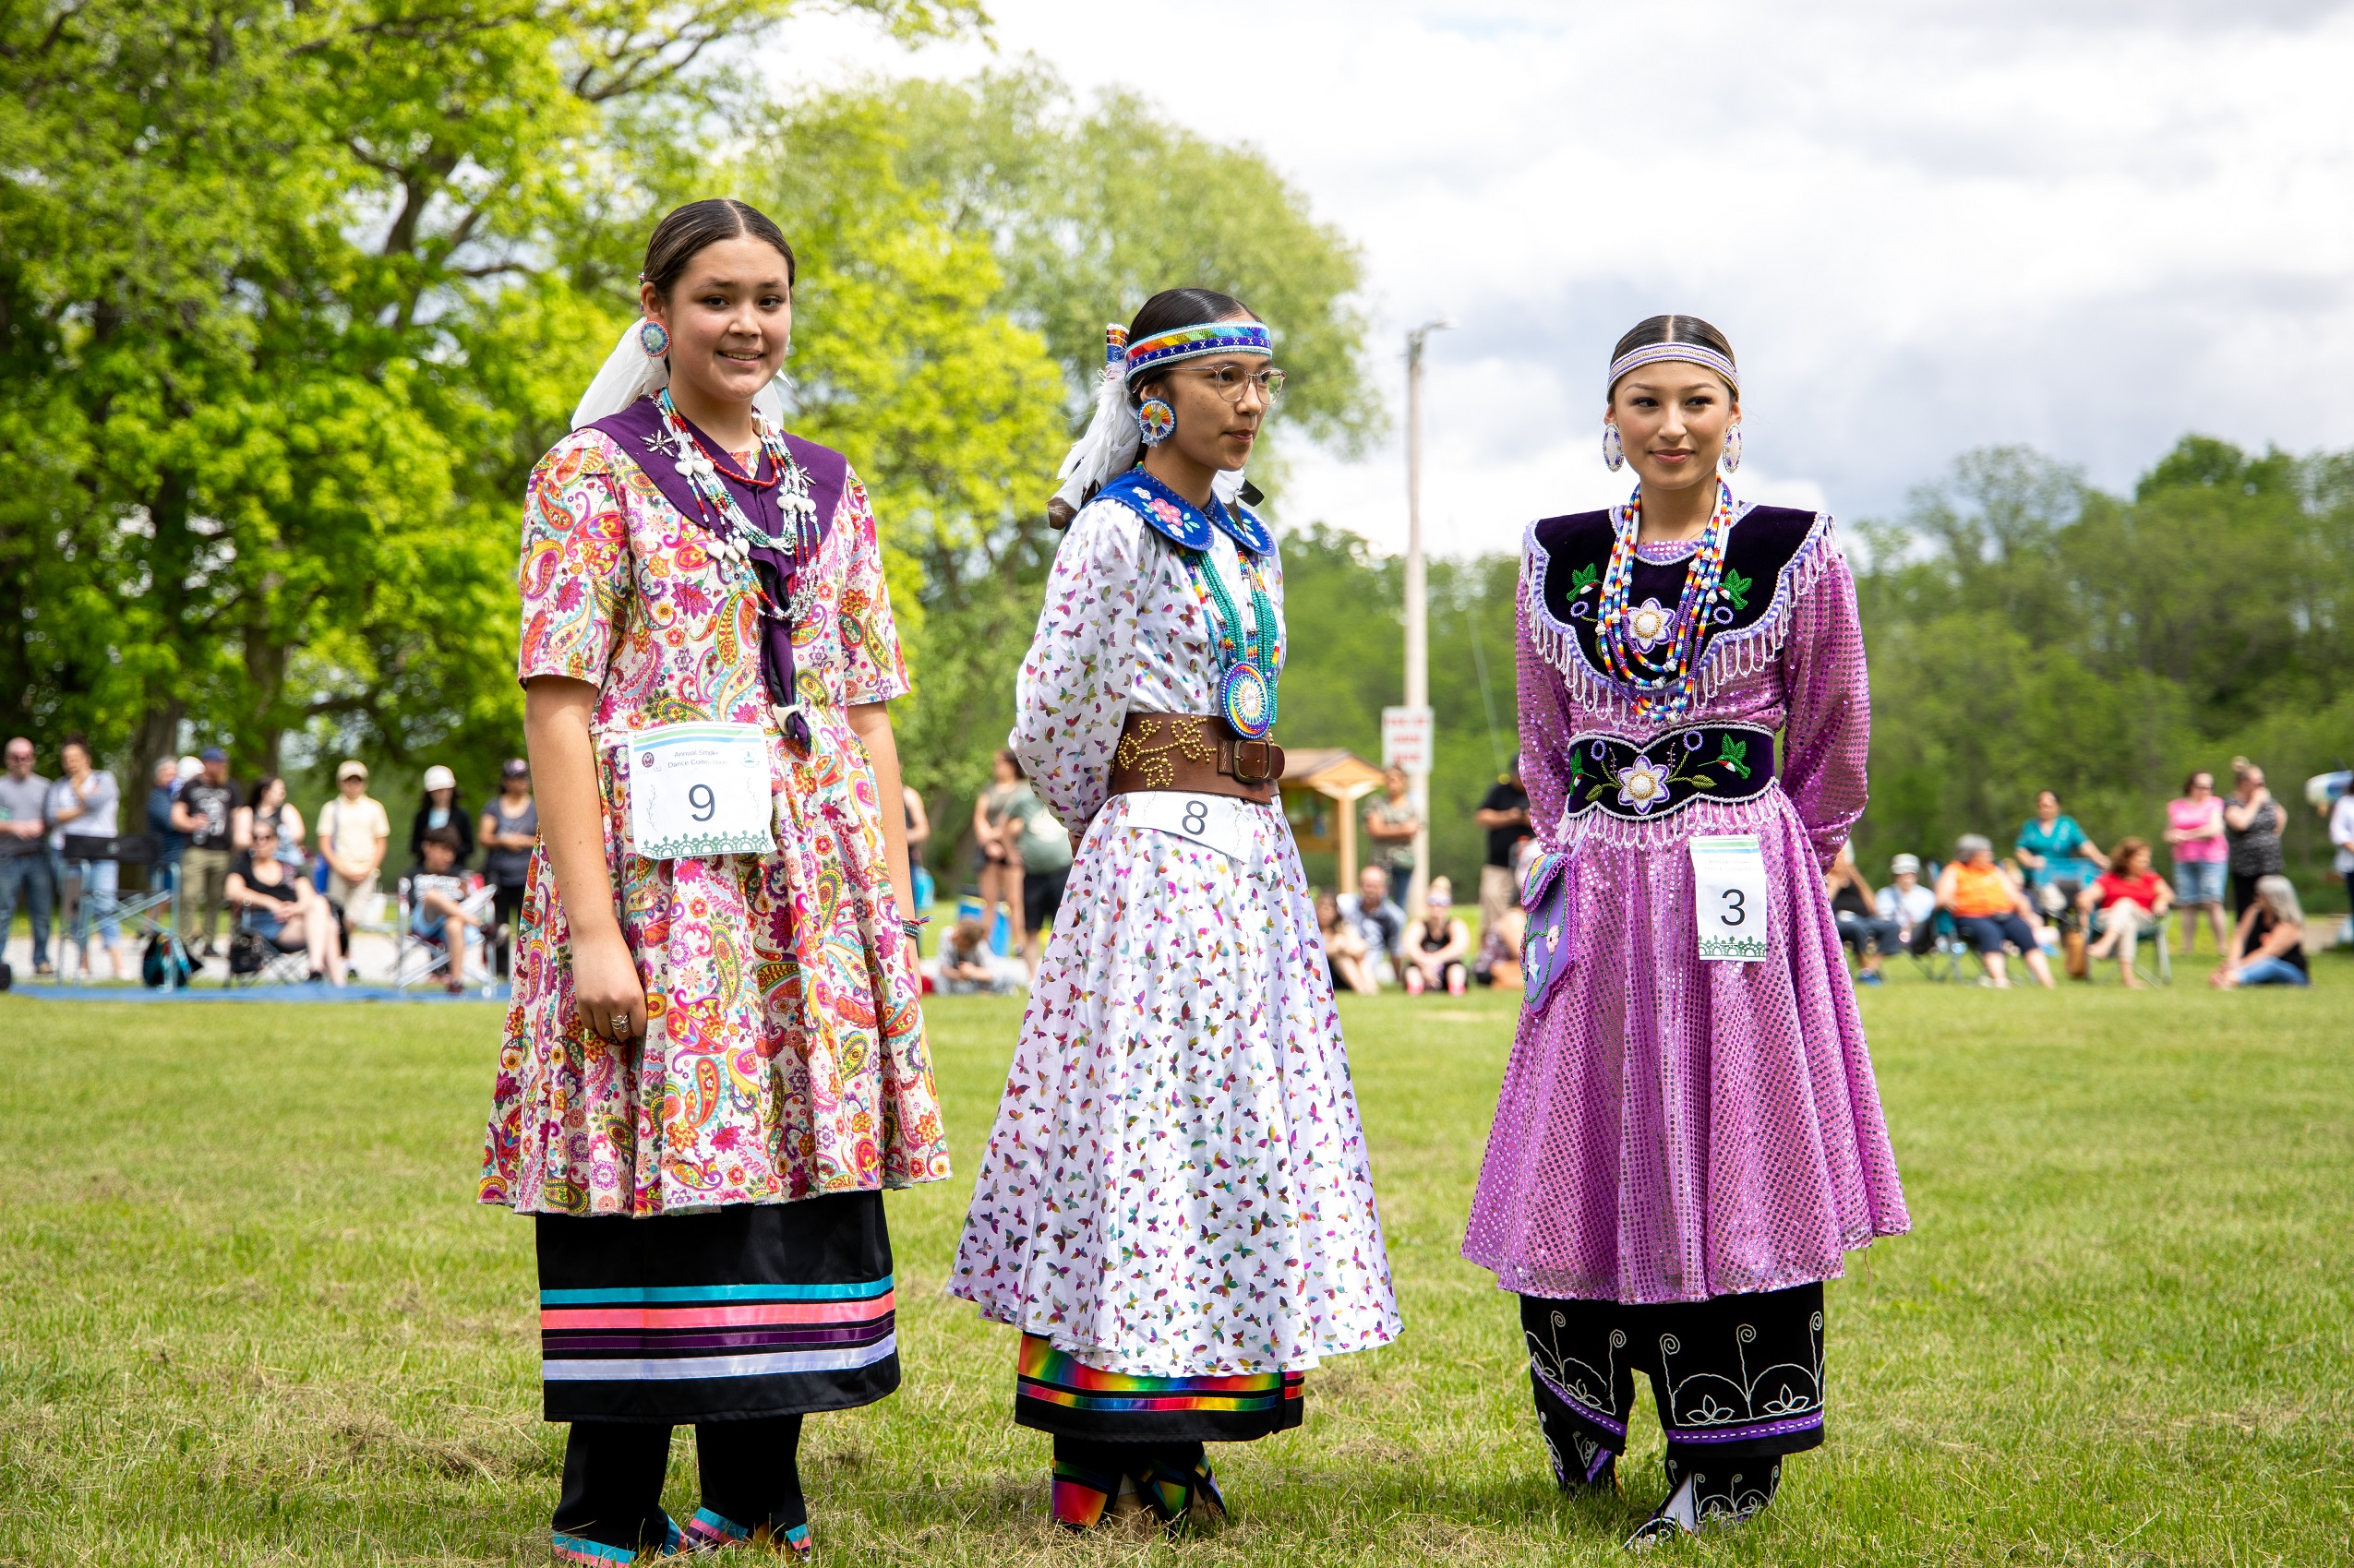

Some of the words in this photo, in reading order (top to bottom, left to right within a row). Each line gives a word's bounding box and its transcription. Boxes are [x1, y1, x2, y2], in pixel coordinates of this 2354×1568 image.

[675, 749, 697, 758] Annual
[689, 784, 715, 821] 9
[1182, 800, 1208, 836] 8
[1721, 889, 1746, 926] 3
